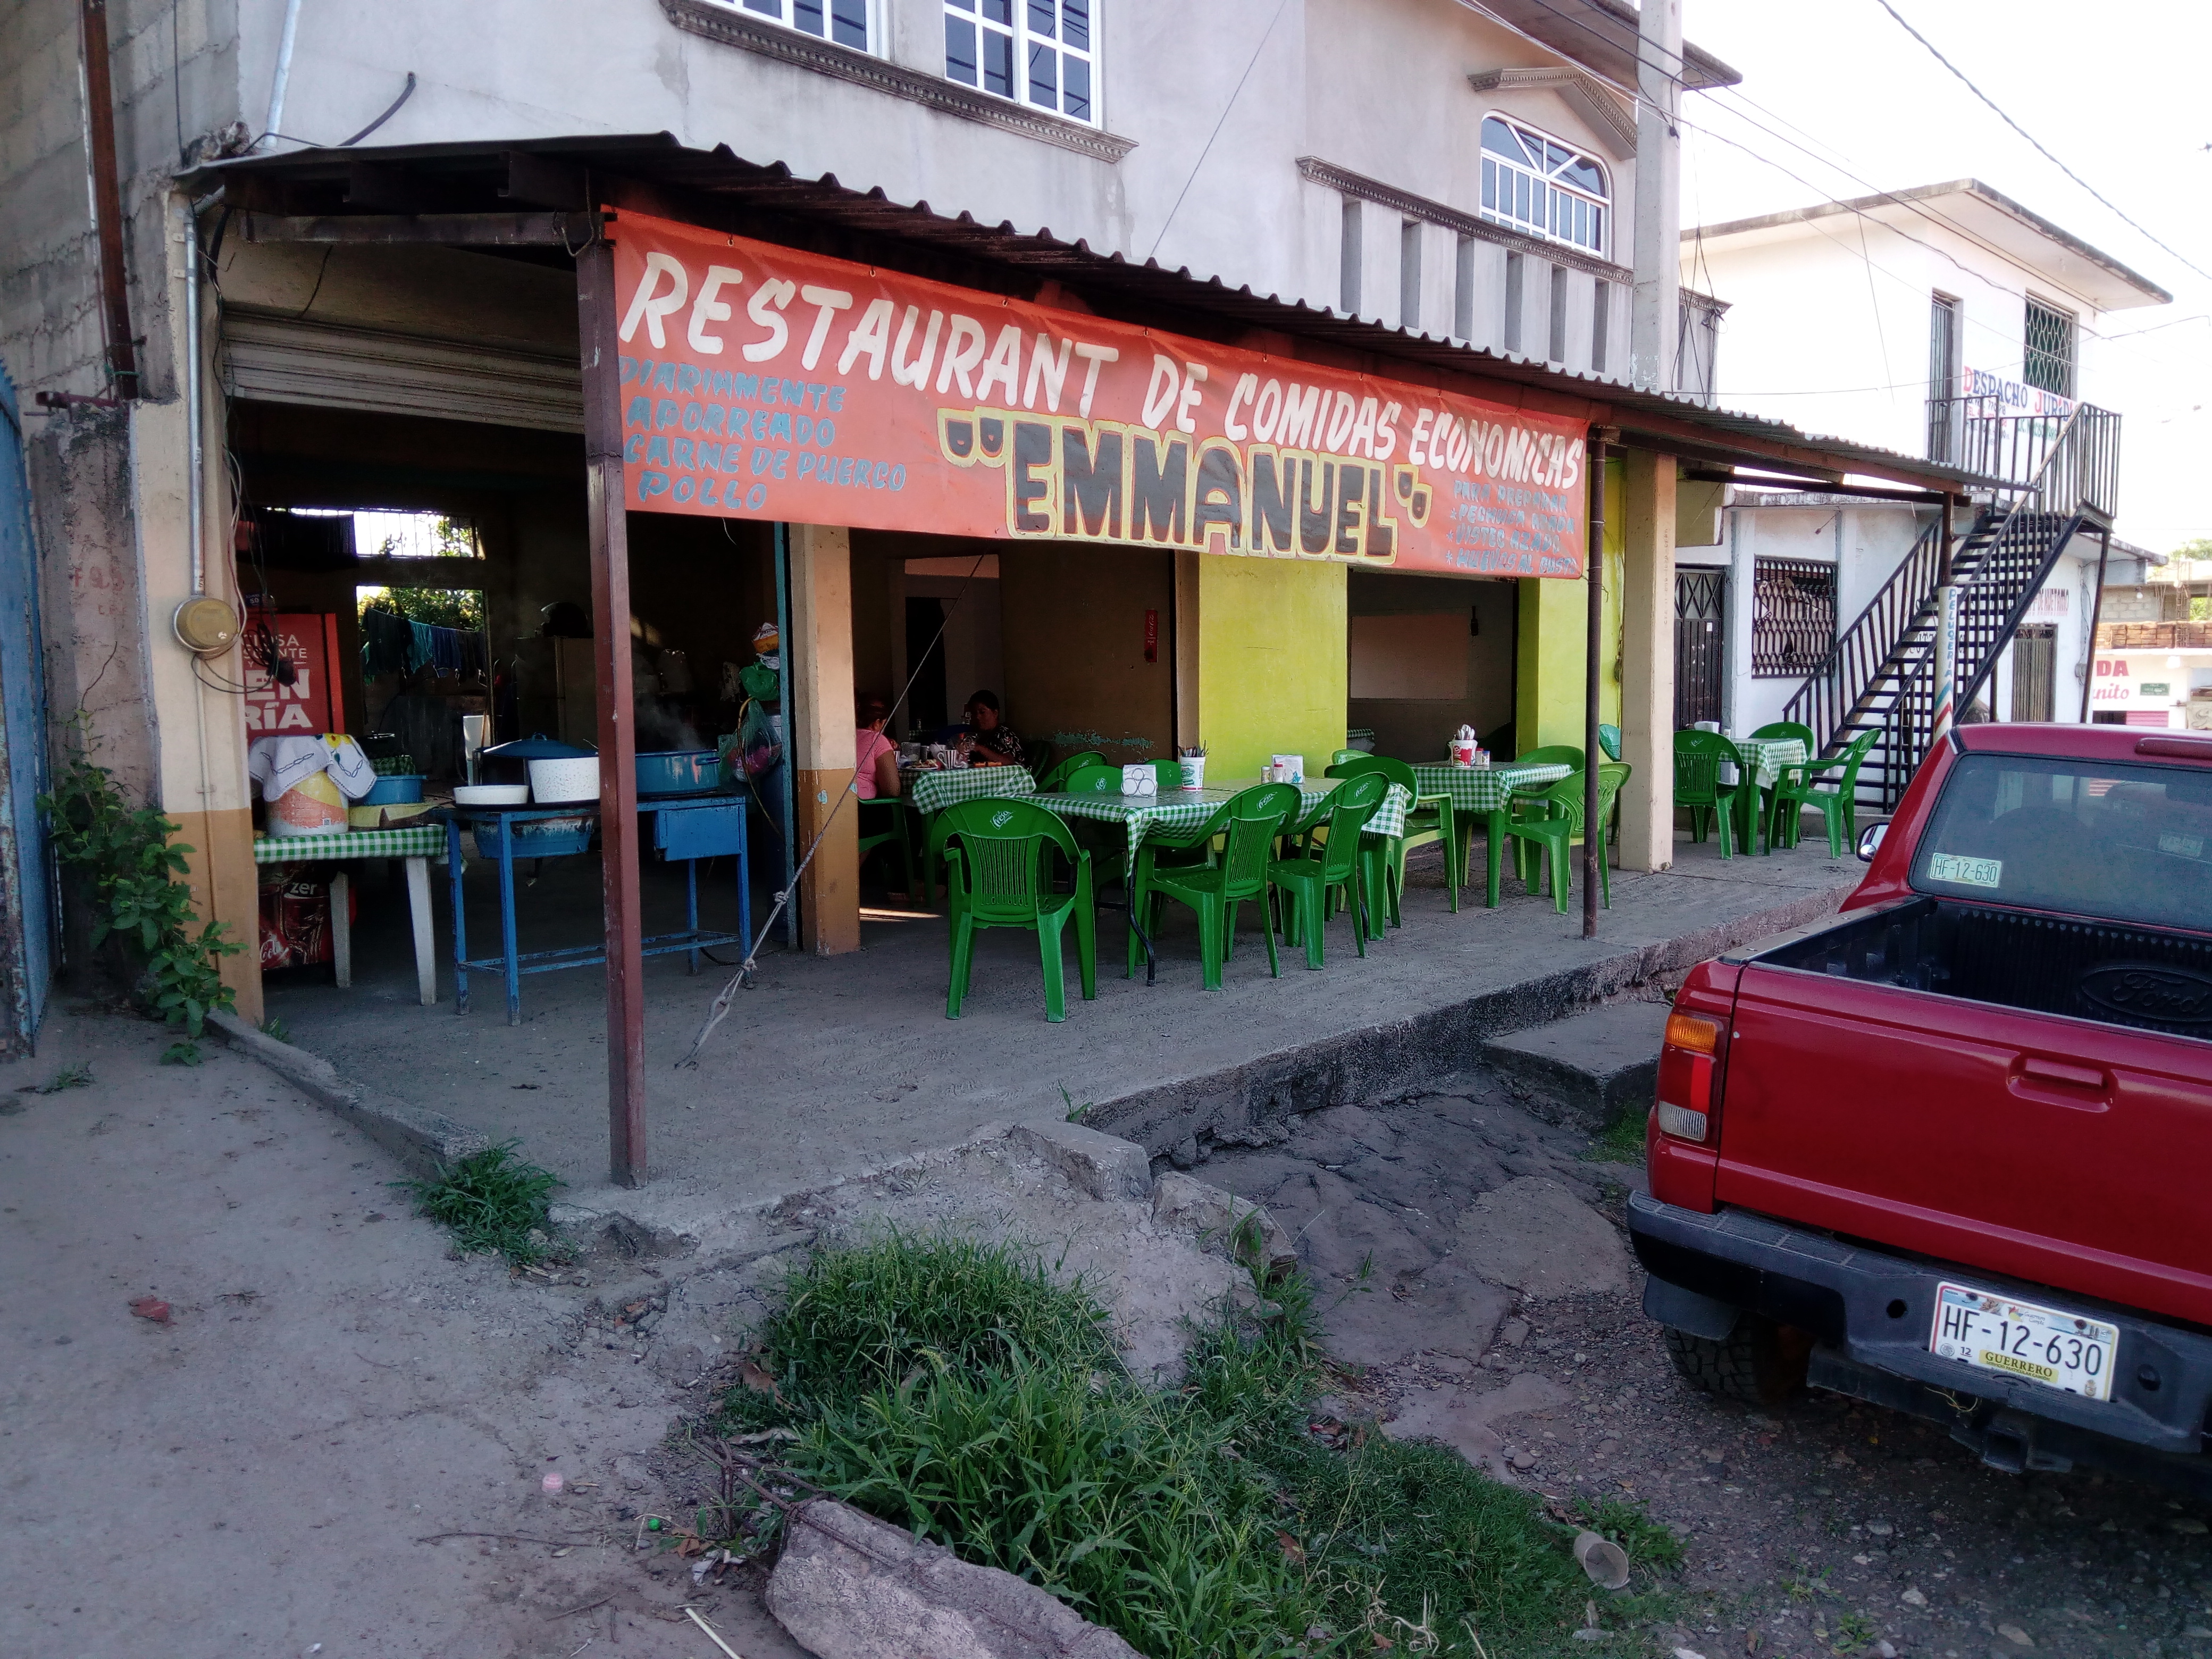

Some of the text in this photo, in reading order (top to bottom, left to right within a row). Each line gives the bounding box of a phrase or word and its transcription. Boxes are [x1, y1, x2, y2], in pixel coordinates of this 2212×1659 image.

[619, 252, 1585, 490] RESTAURANT DE COMIDAS ECONOMICAS
[1963, 365, 2028, 408] DESPACHO
[626, 396, 836, 448] APORREADO
[623, 433, 907, 492] CARNE DE PUERCO
[638, 471, 767, 510] POLLO
[1454, 480, 1492, 503] PARA
[1516, 552, 1534, 574] AL
[1934, 858, 1998, 882] HF-12-630
[1943, 1304, 2101, 1376] HF-12-630
[1960, 1346, 1972, 1357] 12
[1985, 1352, 2052, 1377] GUERRERO
